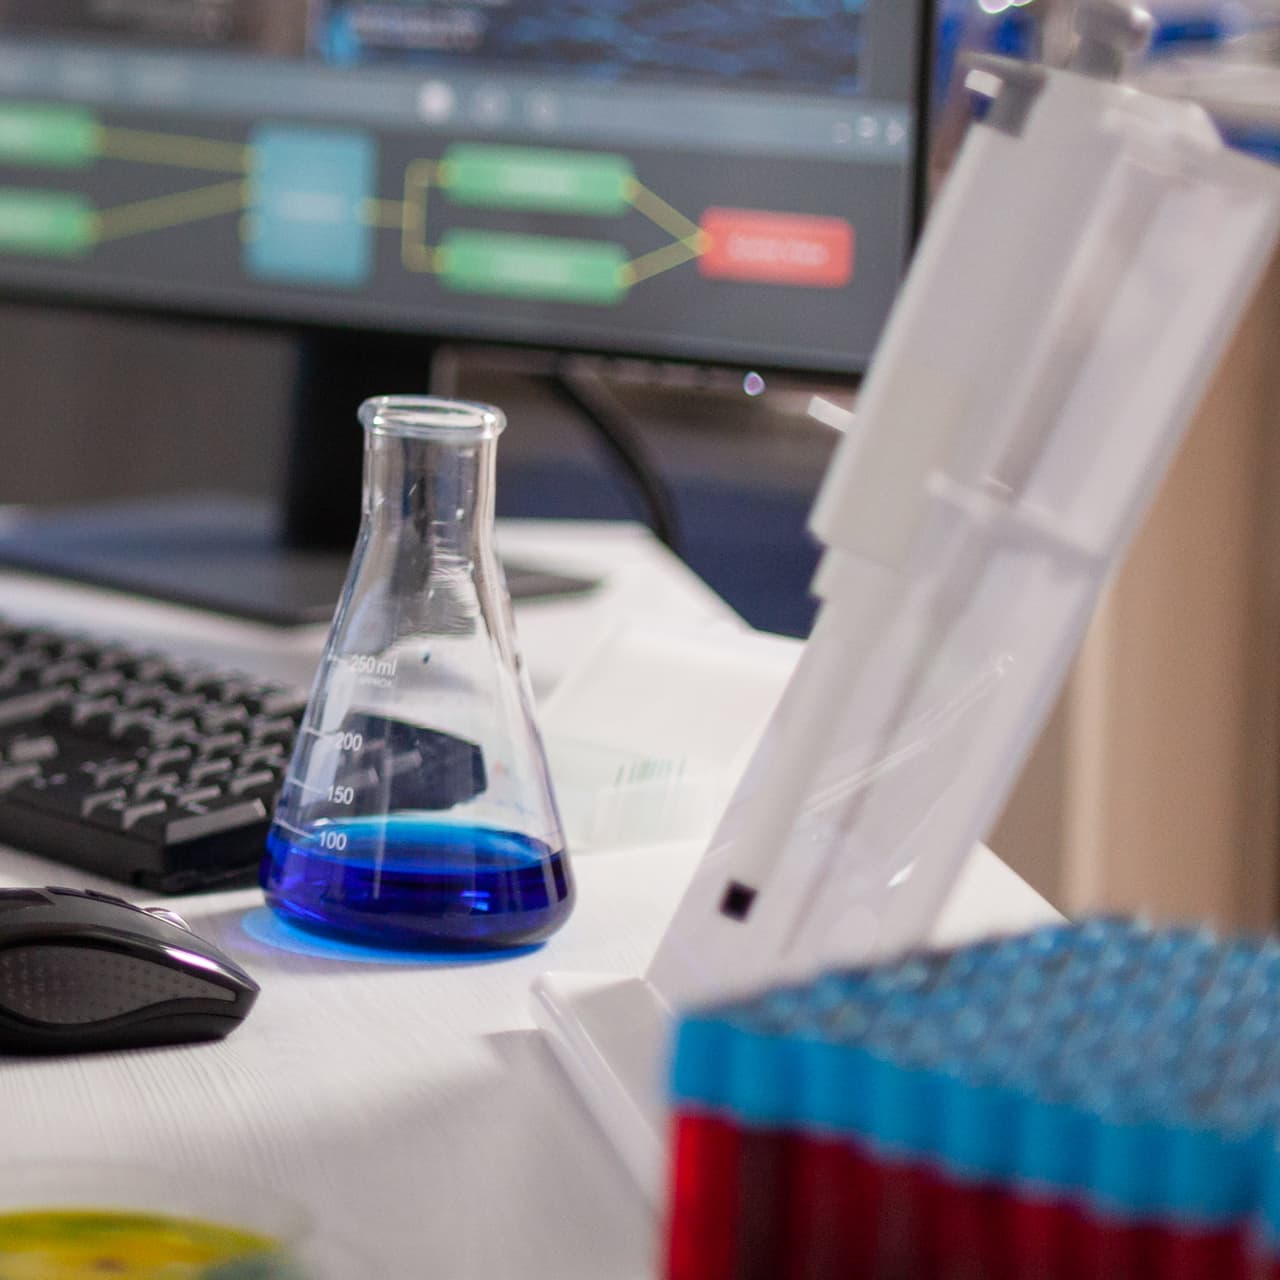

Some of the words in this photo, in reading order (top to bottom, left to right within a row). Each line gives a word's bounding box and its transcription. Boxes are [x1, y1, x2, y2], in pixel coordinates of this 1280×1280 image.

[350, 654, 376, 673] 250
[335, 731, 363, 751] 200
[328, 785, 354, 805] 150
[320, 831, 348, 851] 100
